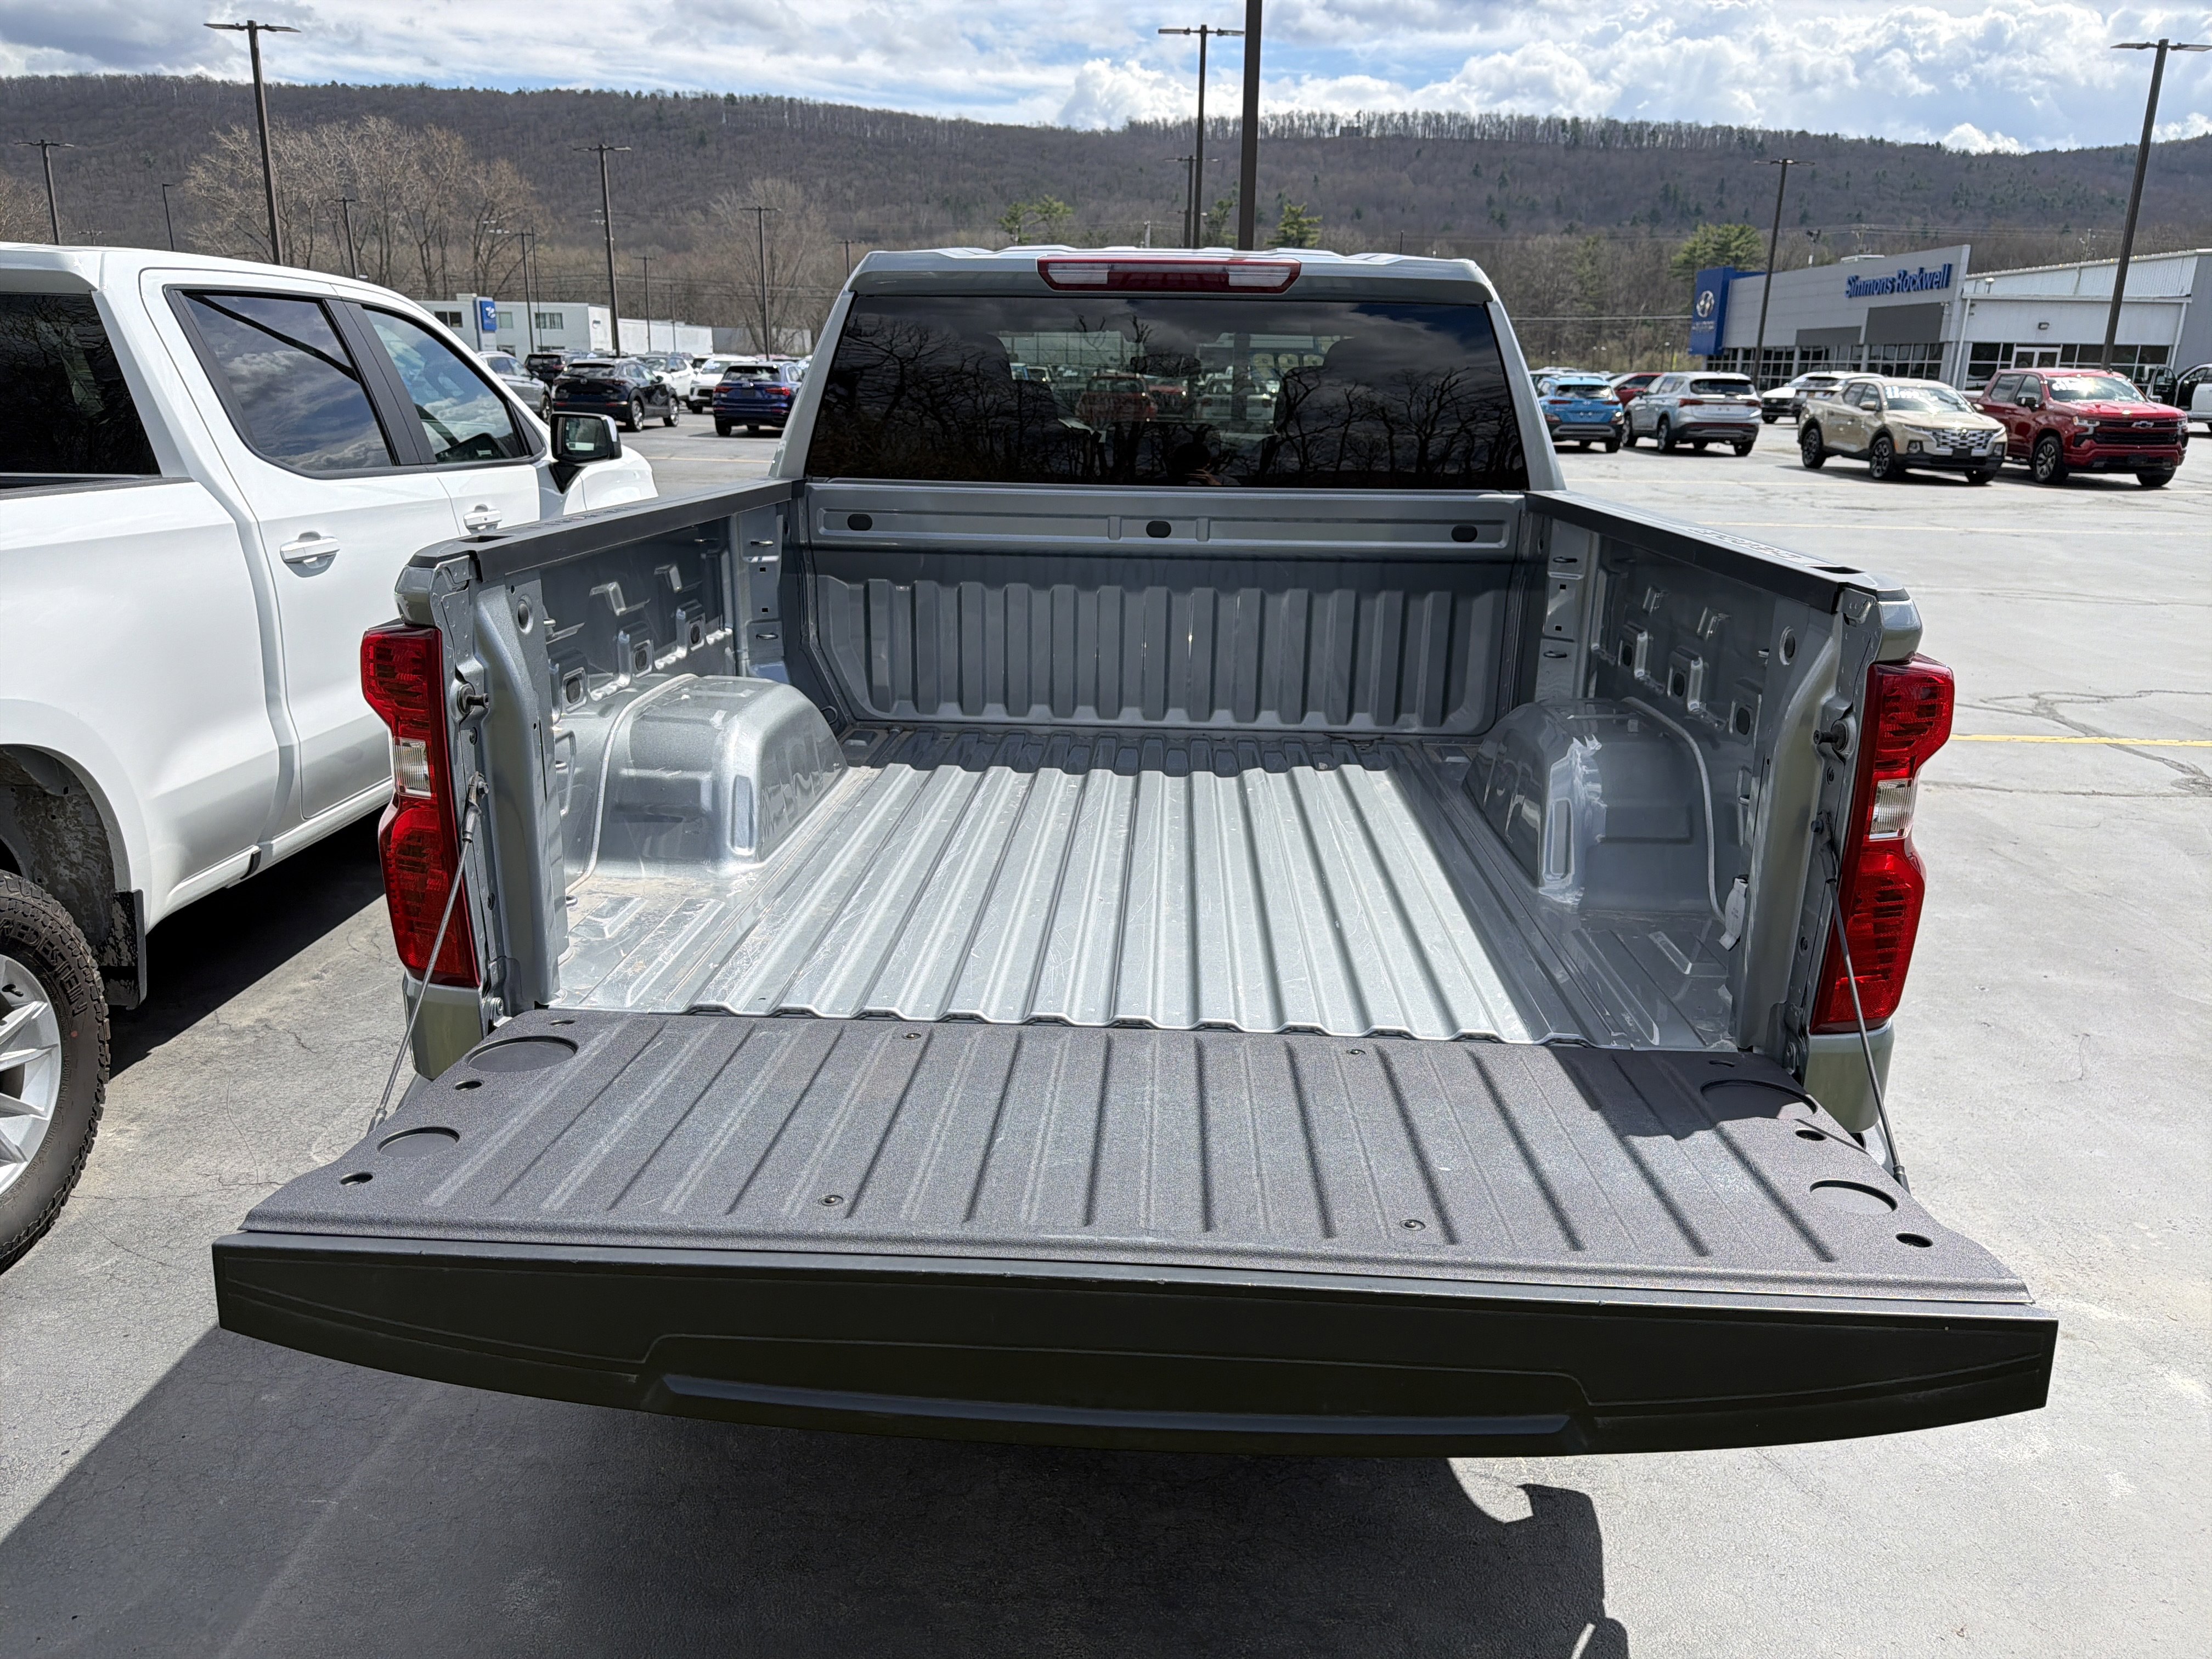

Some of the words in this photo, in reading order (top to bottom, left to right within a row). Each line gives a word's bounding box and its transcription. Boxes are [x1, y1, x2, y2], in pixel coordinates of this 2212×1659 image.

[1845, 275, 1895, 298] Simmons
[1894, 263, 1953, 293] Rockwell
[1688, 528, 1802, 559] CHEVROLET
